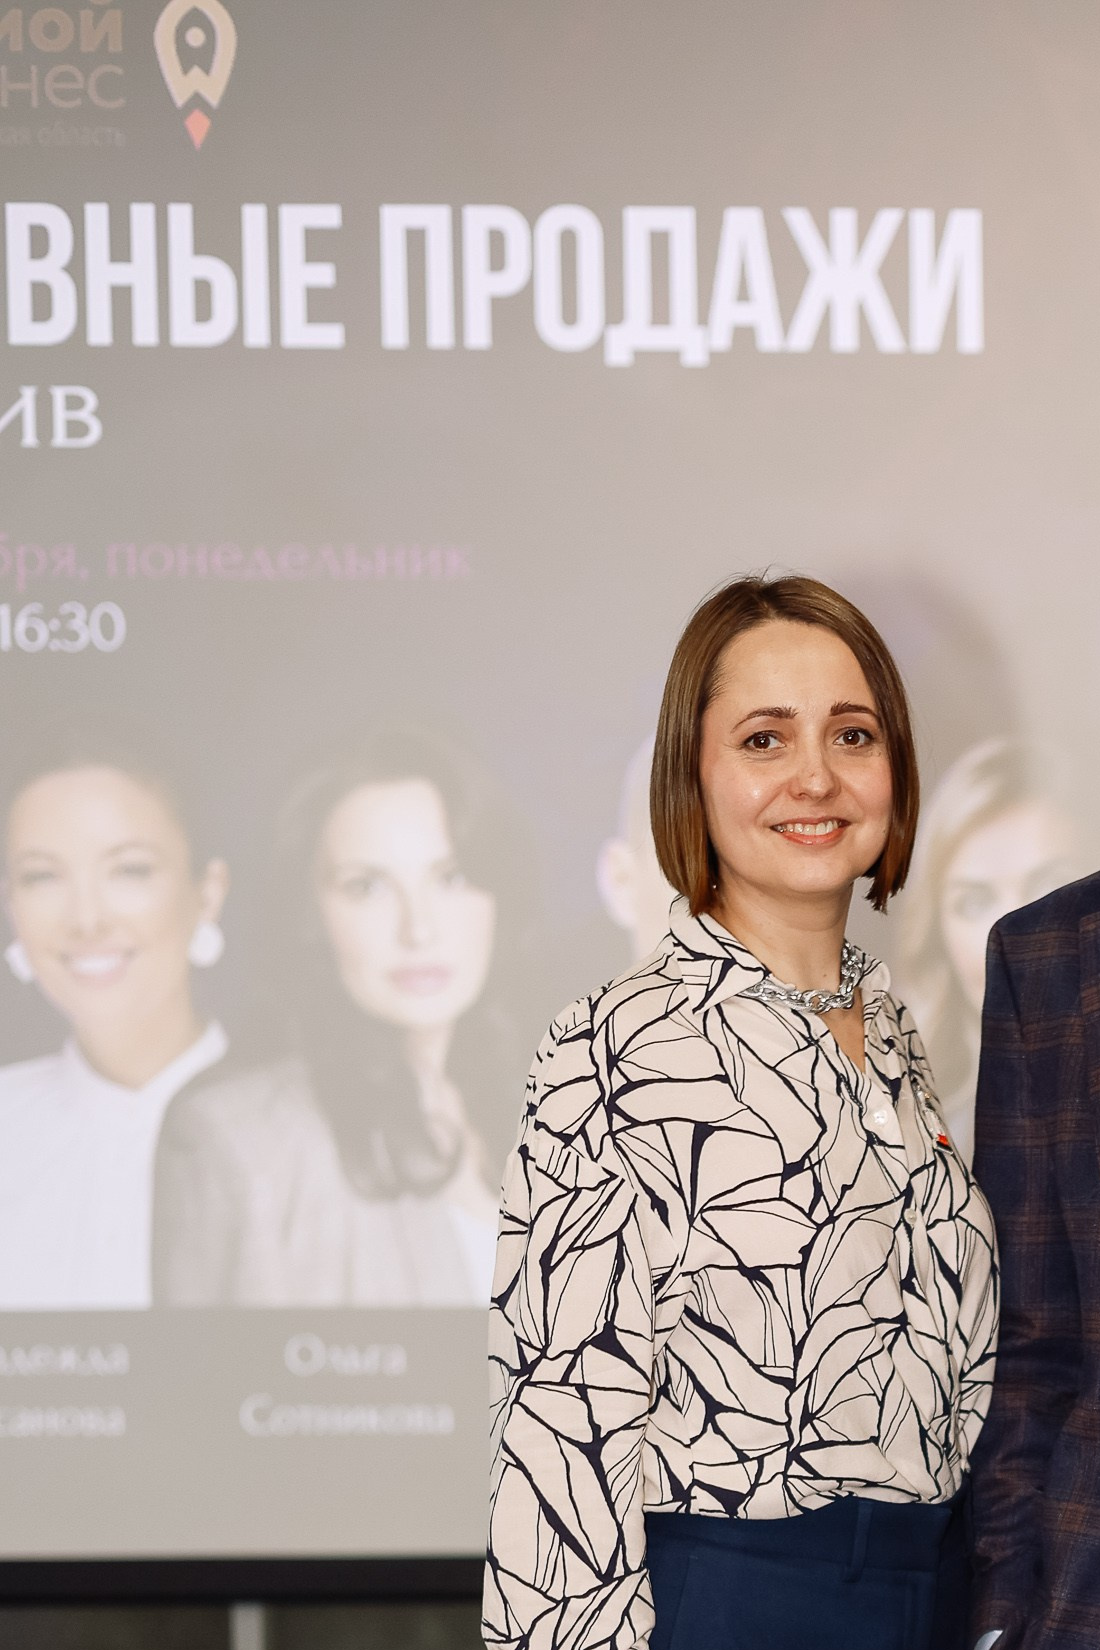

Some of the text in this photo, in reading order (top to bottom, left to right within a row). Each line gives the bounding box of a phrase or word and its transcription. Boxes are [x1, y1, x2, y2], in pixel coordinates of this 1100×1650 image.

[5, 202, 986, 367] ВНЫЕ ПРОДАЖИ
[105, 540, 472, 581] понедельник
